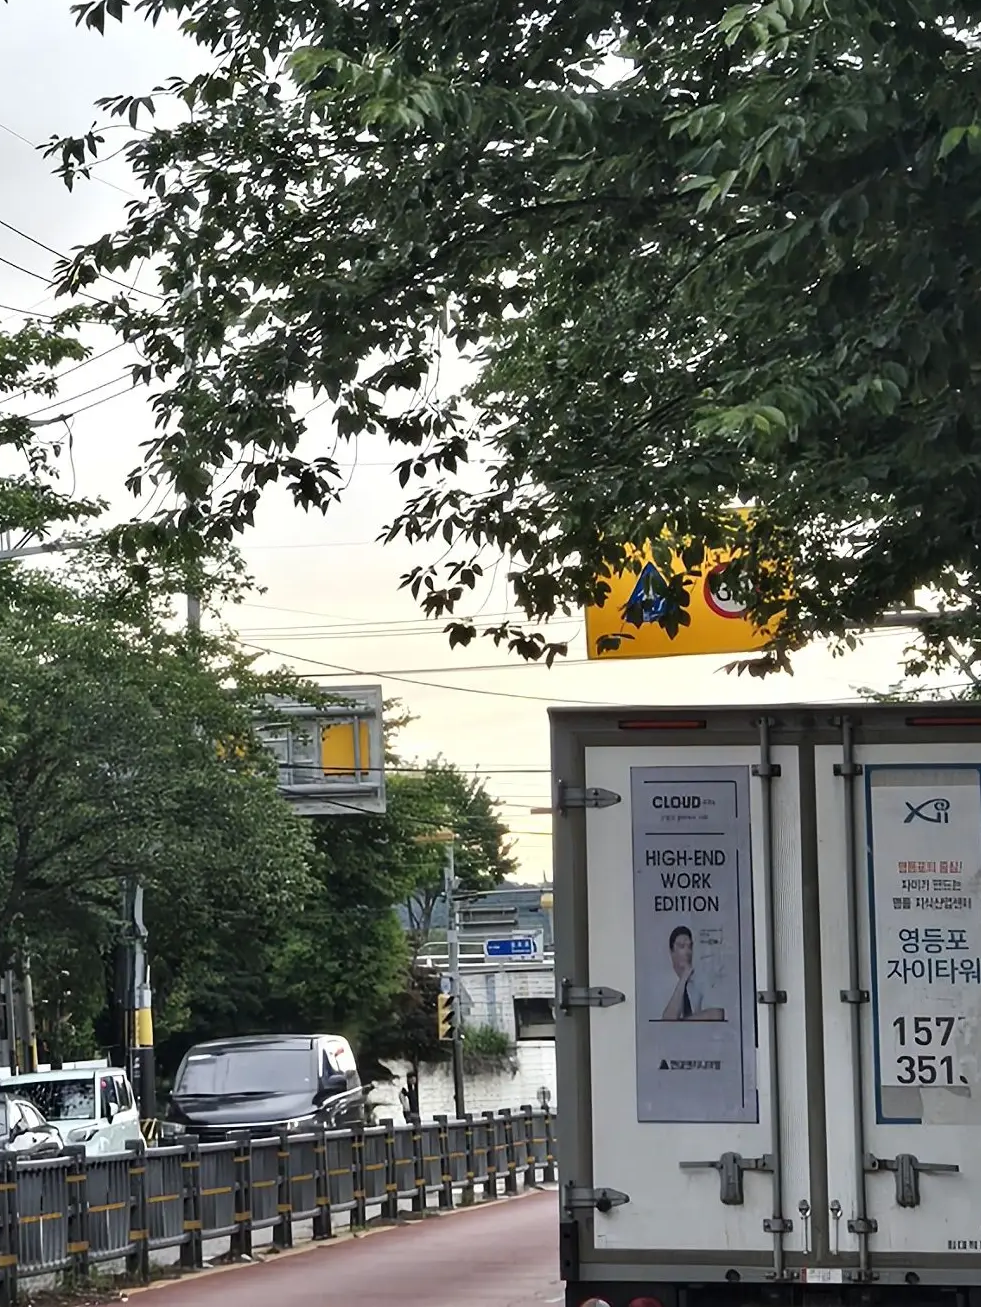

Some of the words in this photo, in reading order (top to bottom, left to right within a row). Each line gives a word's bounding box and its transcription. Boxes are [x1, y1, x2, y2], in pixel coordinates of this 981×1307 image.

[652, 795, 701, 809] CLOUD
[645, 849, 726, 866] HIGH-END
[661, 872, 712, 889] WORK
[654, 895, 719, 912] EDITION
[898, 927, 969, 954] 영등포
[887, 957, 981, 984] 자이타워
[892, 1016, 966, 1046] 157
[896, 1055, 969, 1085] 351
